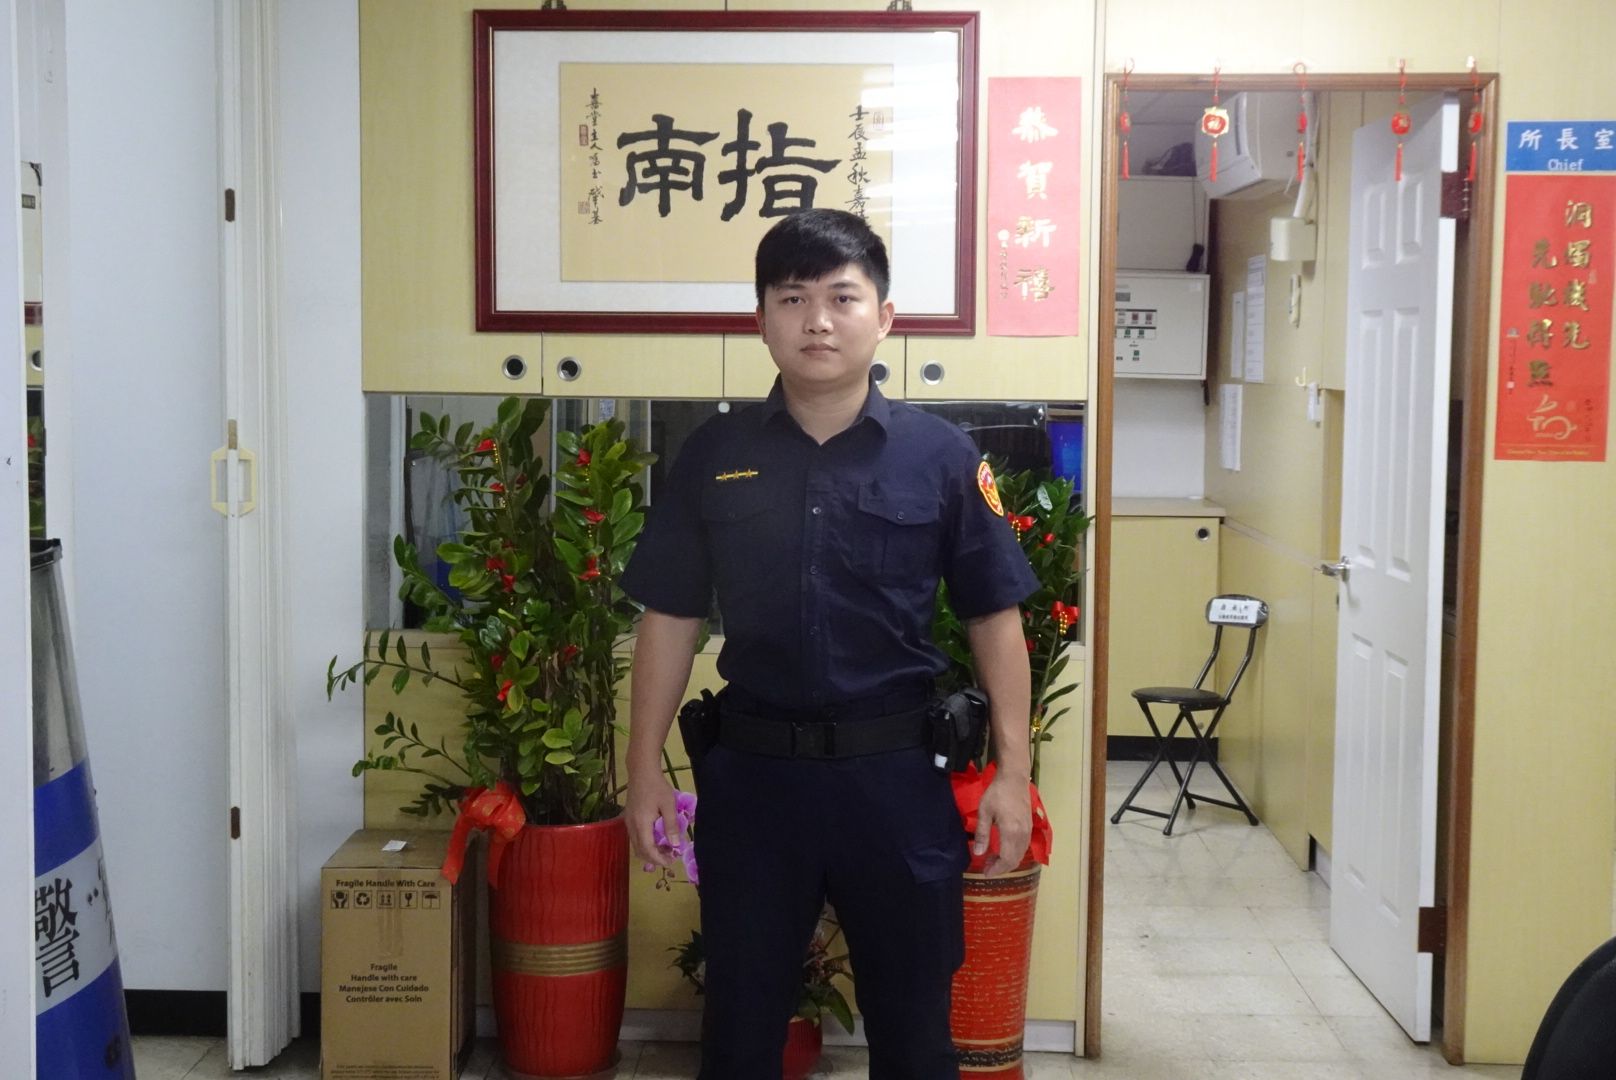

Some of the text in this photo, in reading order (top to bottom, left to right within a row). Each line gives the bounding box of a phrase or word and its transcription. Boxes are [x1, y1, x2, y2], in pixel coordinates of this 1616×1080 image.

[1518, 127, 1615, 151] 所長室
[1547, 158, 1584, 171] Chief
[1012, 106, 1058, 303] 恭賀新禧
[336, 880, 364, 888] Fragile
[35, 878, 80, 998] 警
[370, 963, 398, 972] Fragile
[405, 995, 423, 1003] Soin
